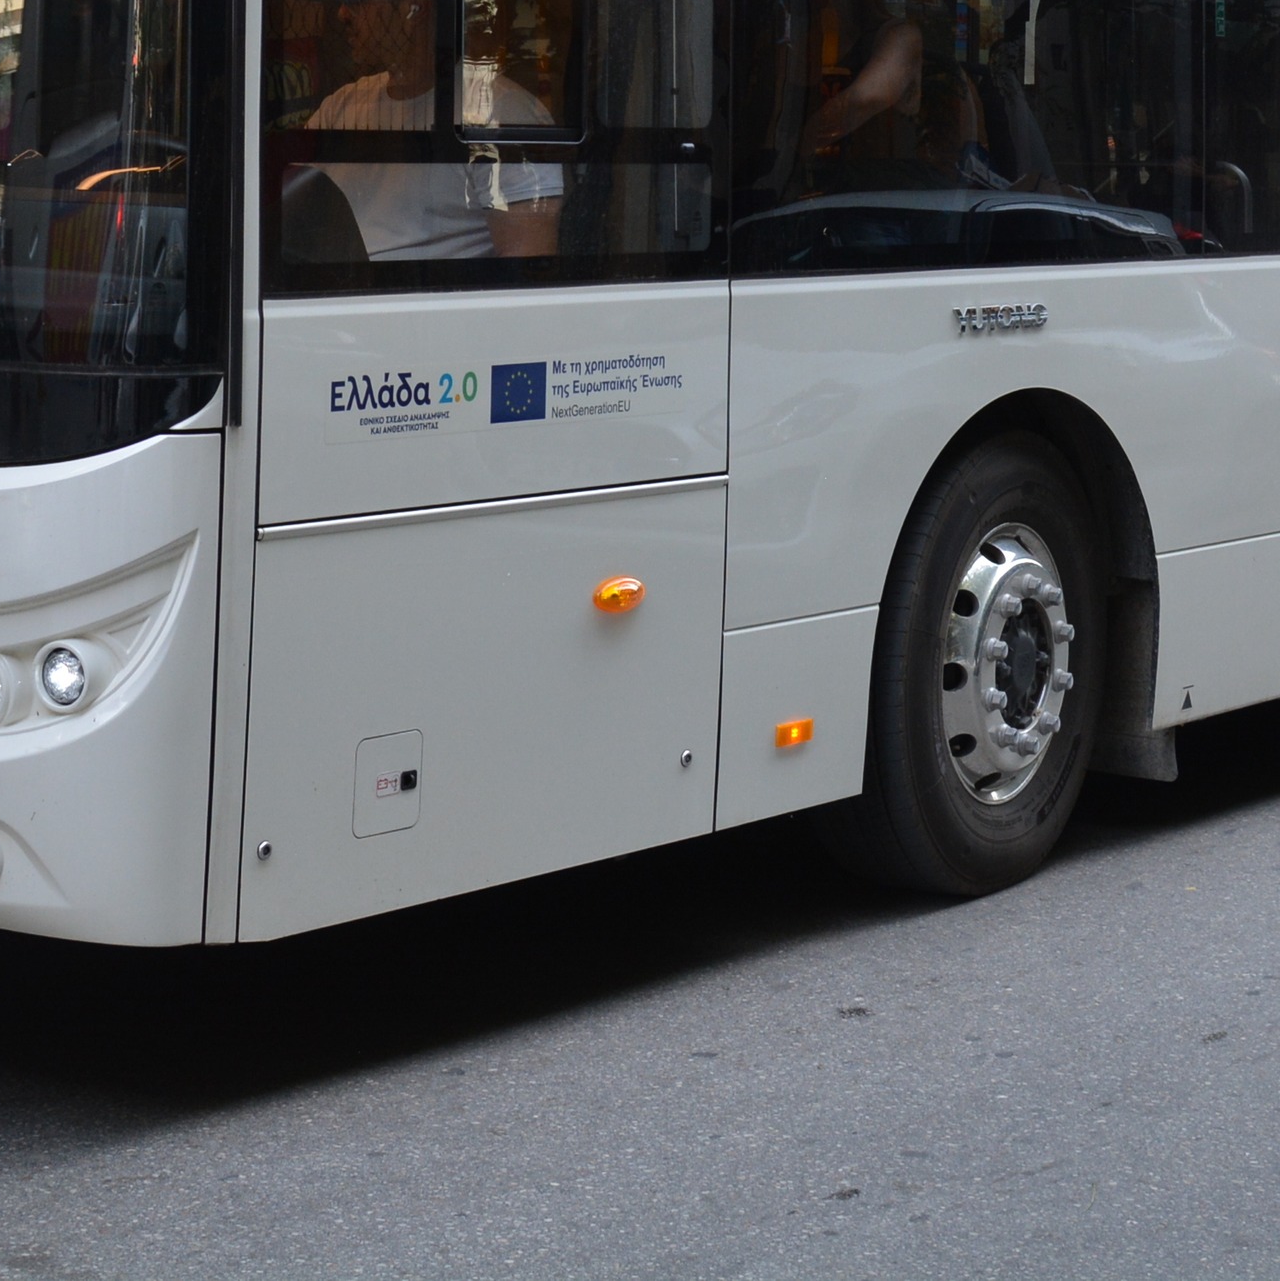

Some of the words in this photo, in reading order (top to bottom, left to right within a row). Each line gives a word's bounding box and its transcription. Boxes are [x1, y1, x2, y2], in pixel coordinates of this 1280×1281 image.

[552, 360, 567, 374] Με
[569, 362, 582, 376] τη
[585, 354, 666, 376] χρηματοδότηση
[330, 372, 431, 412] Ελλάδα
[438, 371, 478, 404] 2.0
[552, 384, 570, 398] της
[572, 376, 638, 396] Ευρωπαϊκής
[639, 374, 683, 389] Ένωσης
[551, 400, 631, 419] NextGenerationEU
[359, 416, 385, 426] ΕΘΝΙΚΟ
[385, 414, 409, 424] ΣΧΕΔΙΟ
[370, 426, 382, 435] ΚΑΙ
[382, 422, 439, 434] ΑΝΘΕΚΤΙΚΟΤΗΤΑΣ
